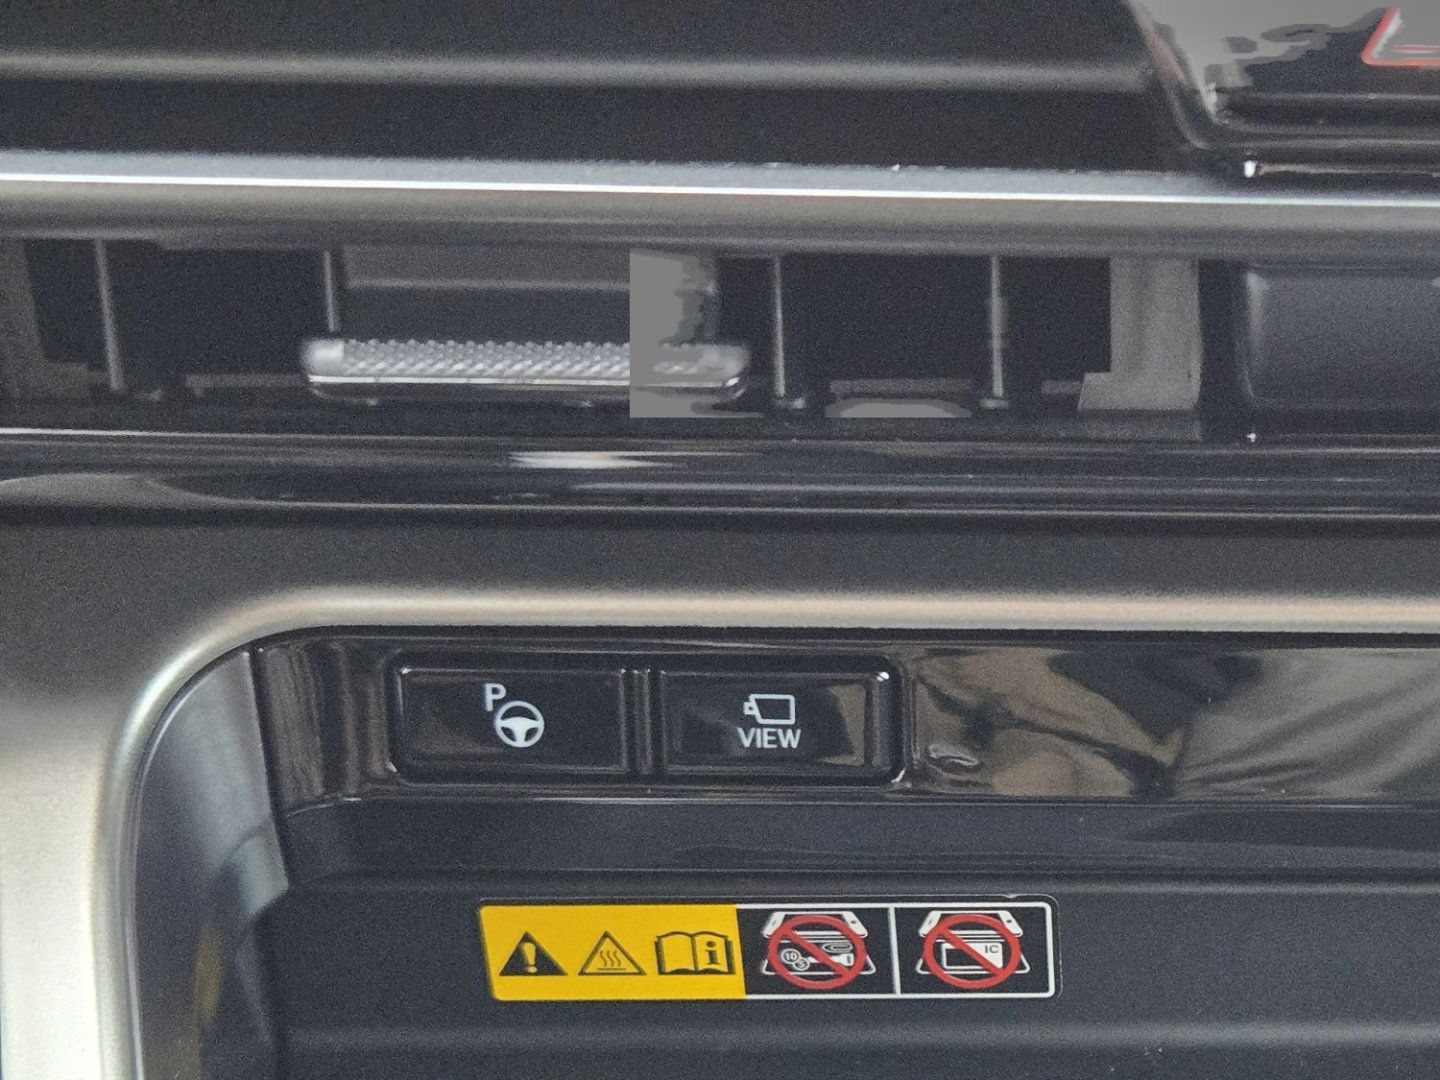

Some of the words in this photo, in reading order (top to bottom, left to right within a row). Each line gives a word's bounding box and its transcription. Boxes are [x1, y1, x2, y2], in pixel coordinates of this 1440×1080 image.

[485, 683, 507, 712] P
[737, 727, 802, 749] VIEW
[984, 944, 1000, 954] IC
